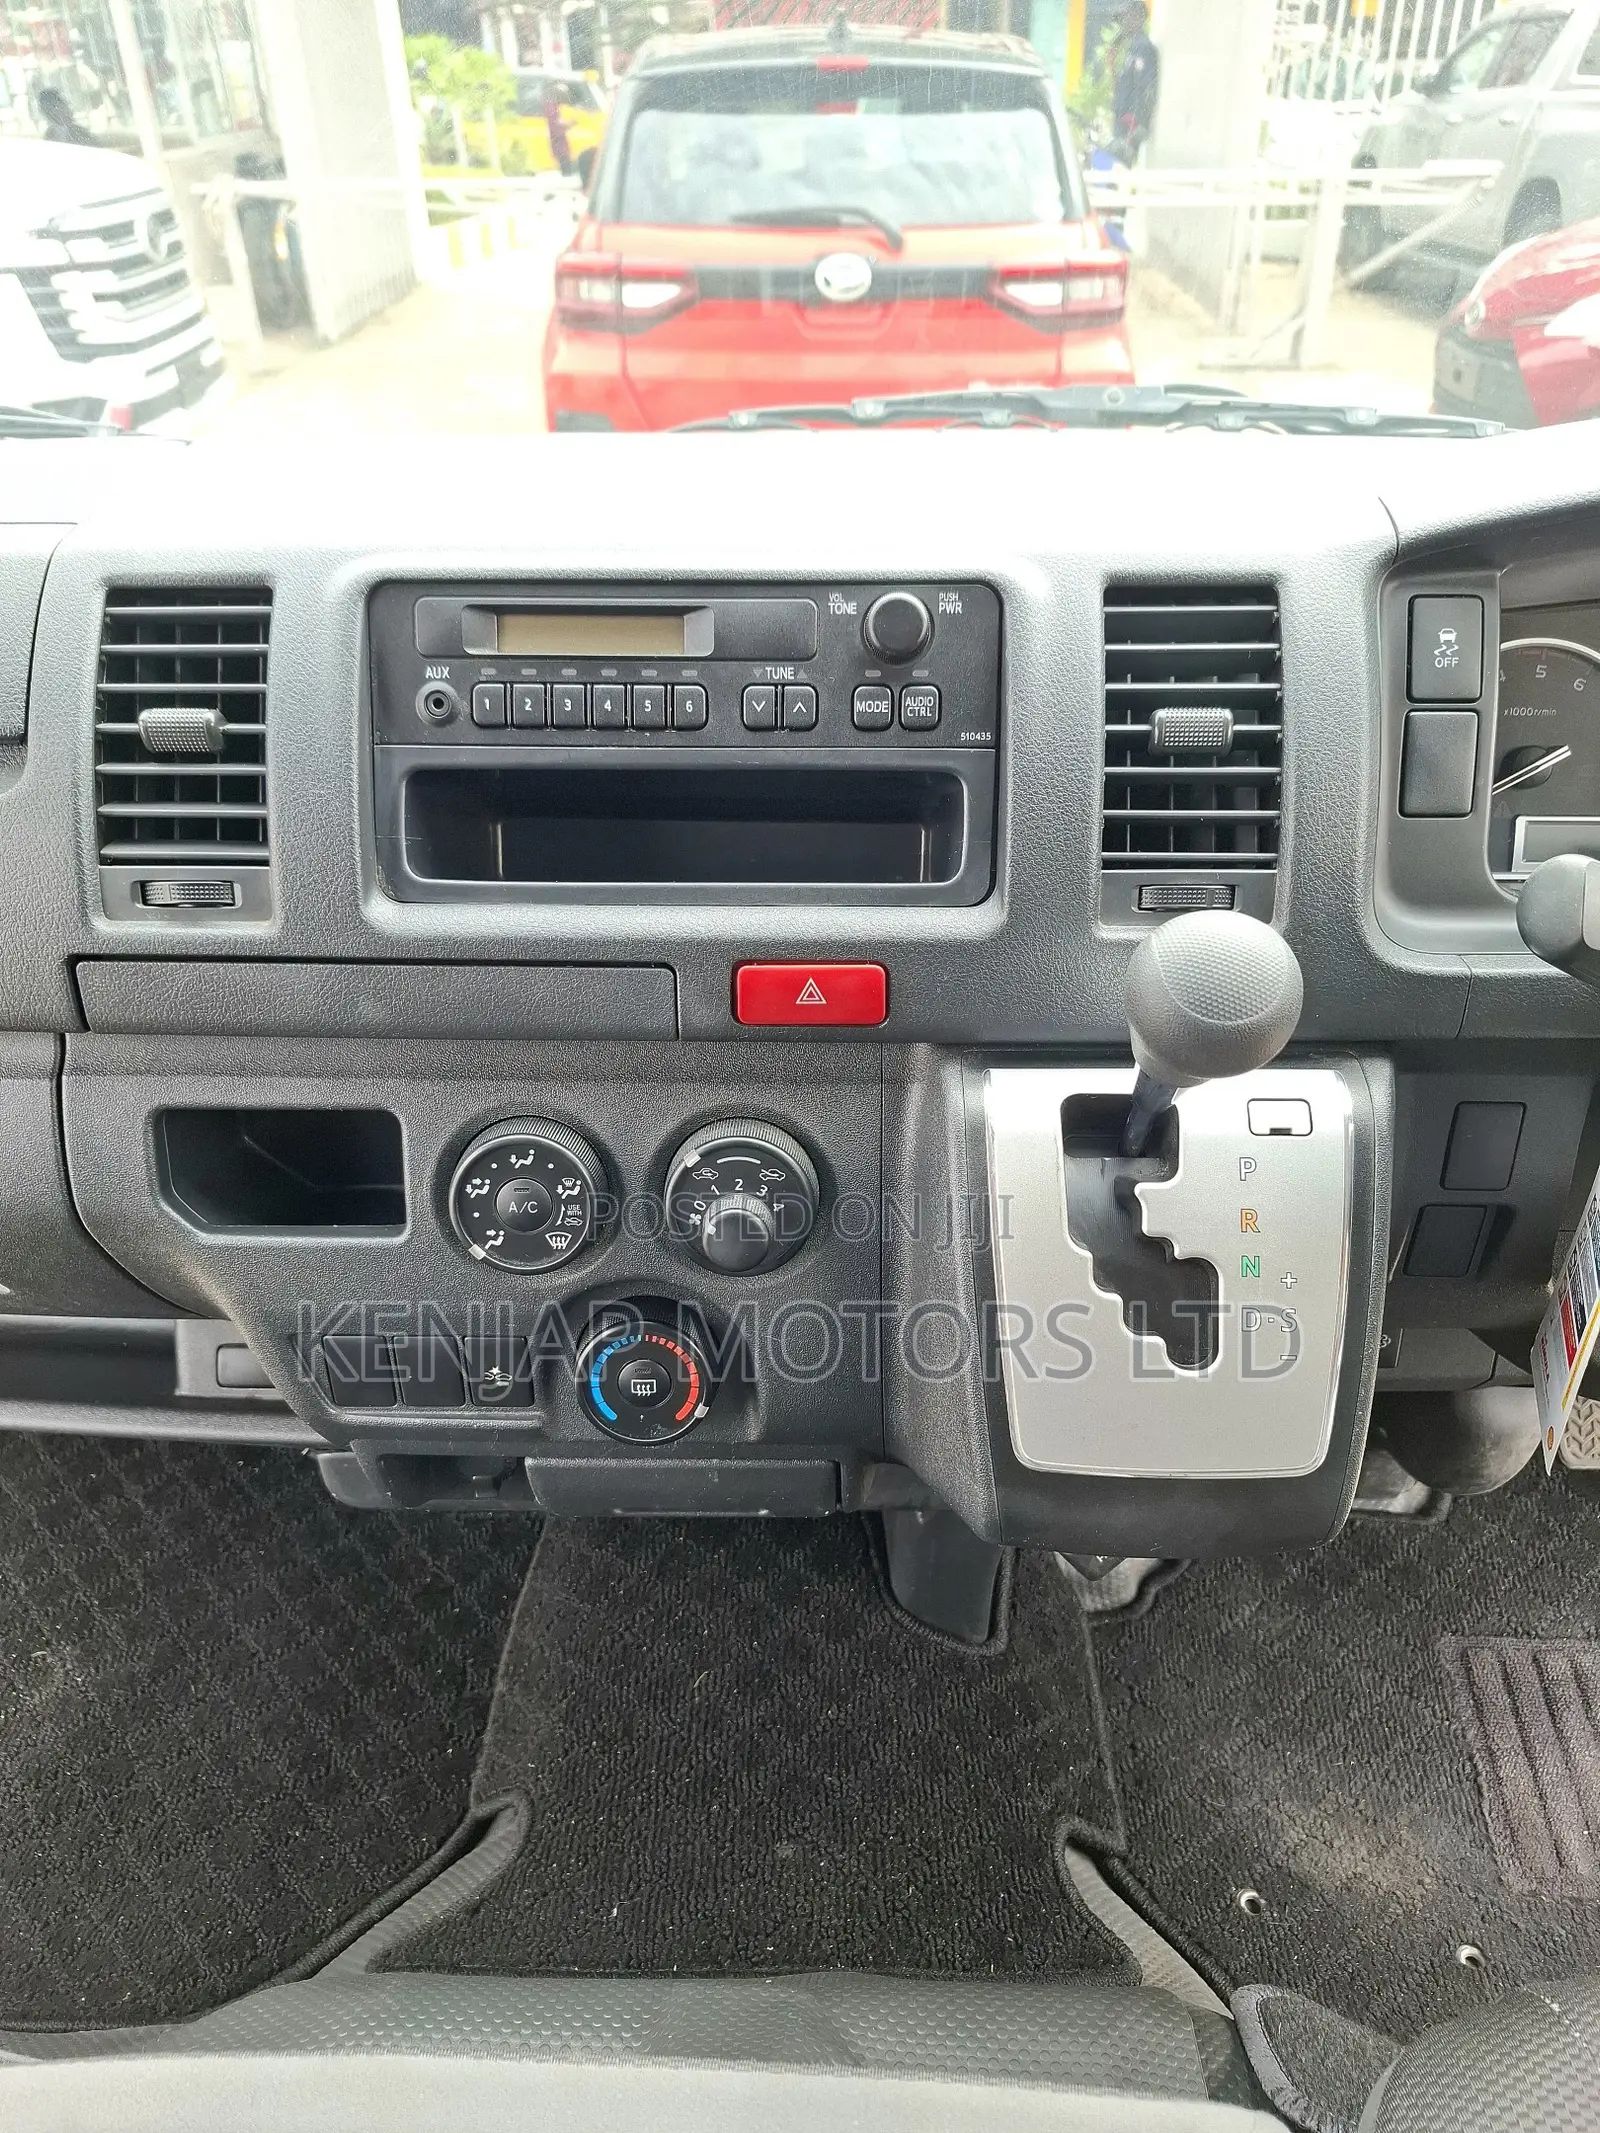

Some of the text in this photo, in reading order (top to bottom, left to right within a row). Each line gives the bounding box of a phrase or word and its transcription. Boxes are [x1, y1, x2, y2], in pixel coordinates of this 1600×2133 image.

[829, 592, 845, 602] VOL
[938, 592, 959, 602] PUSH
[828, 603, 857, 615] TONE
[938, 603, 963, 615] PWR
[1434, 656, 1460, 668] OFF
[425, 666, 451, 679] AUX
[765, 667, 795, 680] TUNE
[1535, 664, 1548, 679] 5
[1573, 677, 1587, 692] 6
[484, 699, 491, 711] 1
[524, 699, 532, 711] 2
[564, 699, 572, 711] 3
[603, 699, 612, 711] 4
[644, 700, 652, 712] 5
[685, 700, 693, 712] 6
[856, 701, 889, 713] MODE
[905, 696, 934, 707] AUDIO
[907, 707, 932, 717] CTRL
[960, 731, 992, 742] 510435
[1239, 1156, 1257, 1181] P
[710, 1184, 721, 1196] 1
[734, 1178, 744, 1191] 2
[756, 1184, 769, 1197] 3
[508, 1201, 538, 1214] A/C
[772, 1203, 785, 1212] 4
[1240, 1208, 1261, 1234] R
[1241, 1254, 1261, 1278] N
